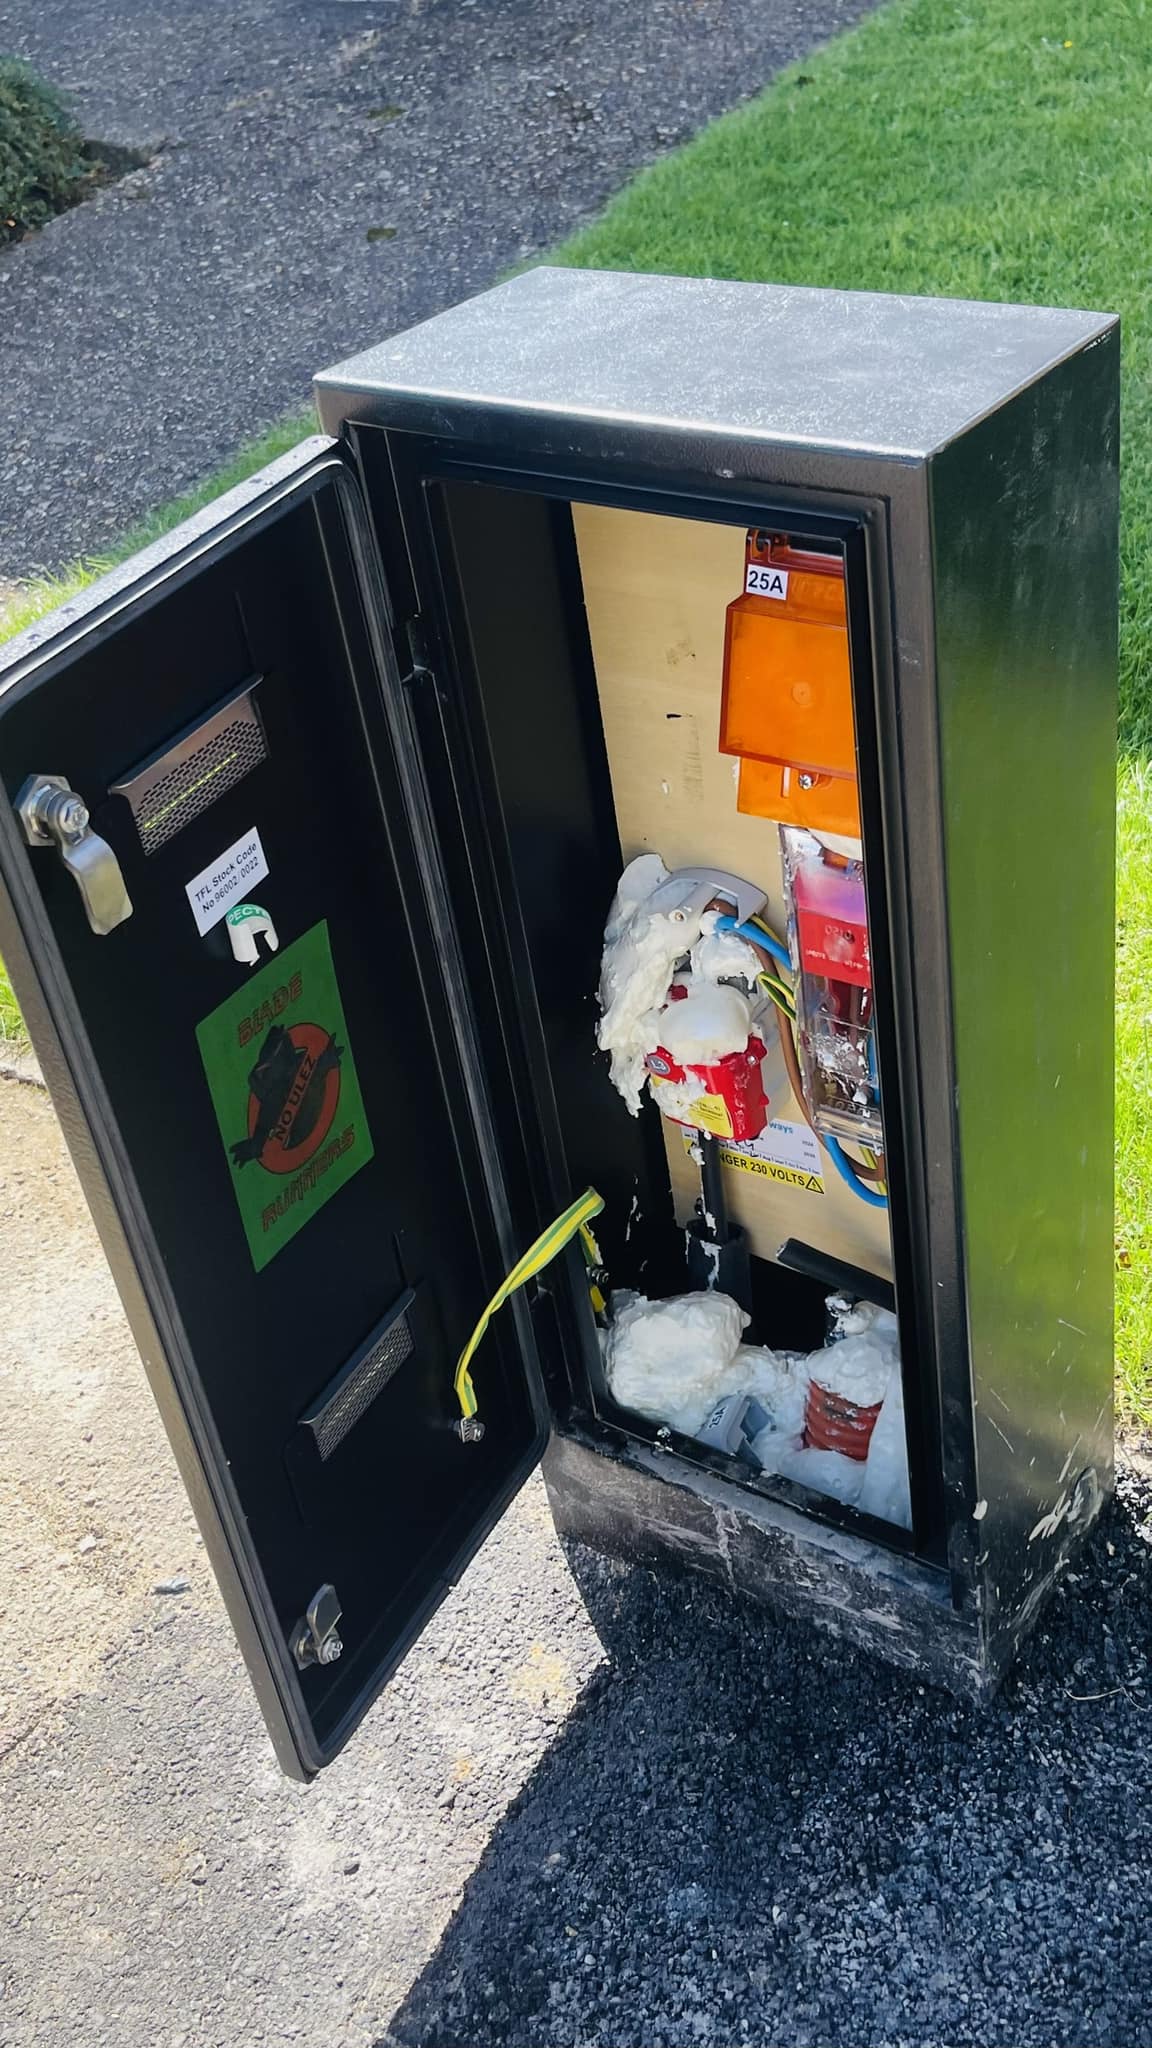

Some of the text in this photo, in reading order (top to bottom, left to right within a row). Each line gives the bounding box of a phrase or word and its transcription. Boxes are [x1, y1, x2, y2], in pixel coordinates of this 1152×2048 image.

[748, 570, 783, 594] 25A
[195, 843, 257, 902] TFL Stock Code
[202, 899, 215, 913] No
[238, 971, 303, 1048] BLADE
[275, 1055, 315, 1142] NO ULEZ
[262, 1123, 354, 1232] RUNNERS
[719, 1152, 805, 1186] NGER 230 VOLTS
